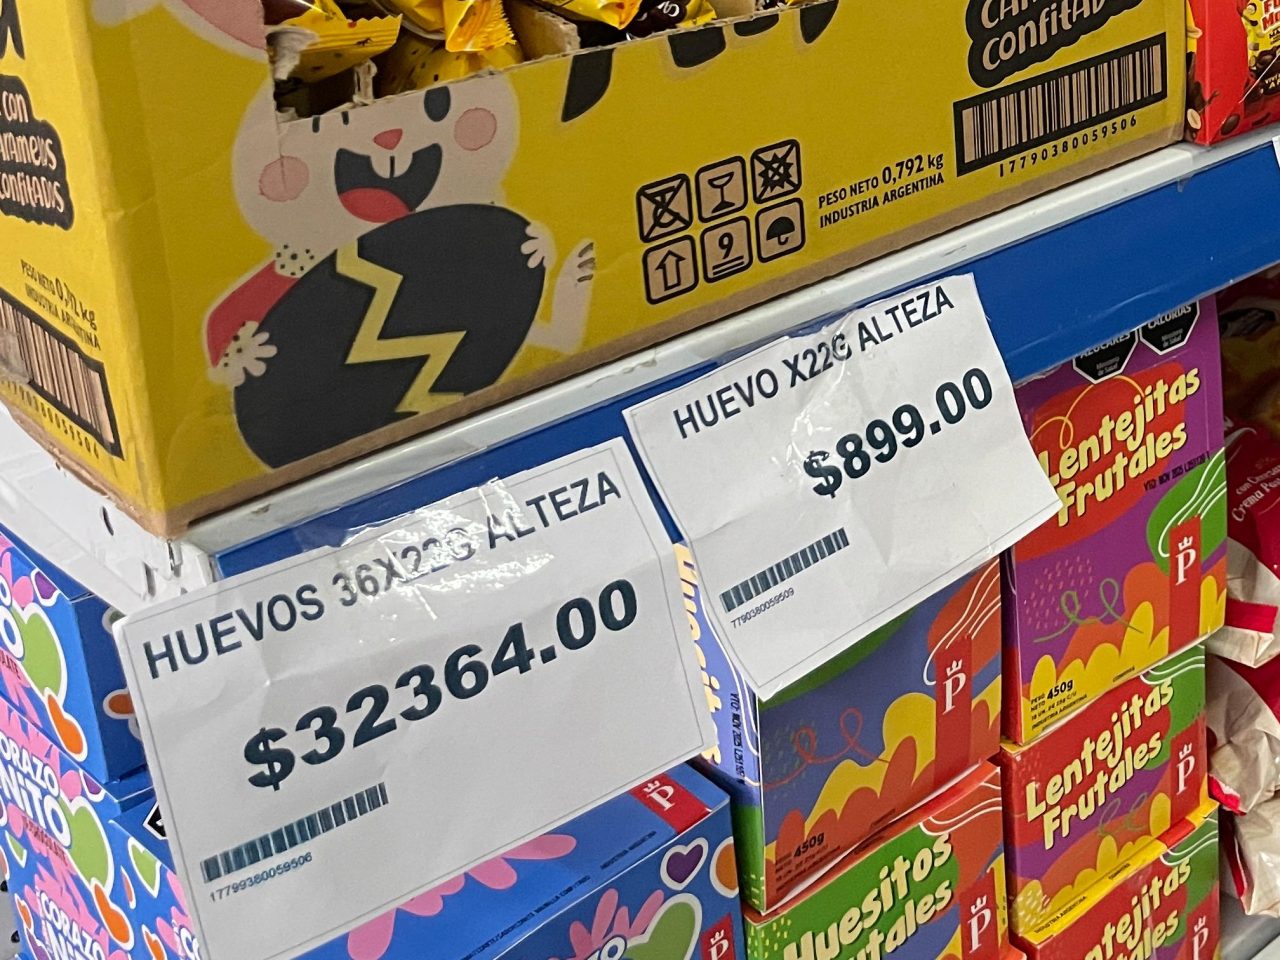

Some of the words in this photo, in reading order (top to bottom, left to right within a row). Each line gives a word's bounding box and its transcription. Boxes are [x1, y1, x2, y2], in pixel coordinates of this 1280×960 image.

[818, 188, 847, 211] PESO
[847, 176, 880, 201] NETO
[926, 153, 945, 173] kg
[818, 198, 880, 230] INDUSTRIA
[881, 172, 945, 208] ARGENTINA
[997, 115, 1138, 178] 17790380059506
[672, 367, 780, 440] HUEVO
[781, 332, 855, 388] X22G
[856, 284, 955, 352] ALTEZA
[803, 367, 994, 499] $899.00
[1038, 366, 1201, 487] Lentejitas
[1056, 421, 1188, 528] Frutales
[142, 583, 326, 680] HUEVOS
[484, 470, 622, 551] ALTEZA
[242, 578, 639, 792] $32364.00
[1046, 679, 1074, 700] 450g
[1025, 677, 1175, 823] Lentejitas
[1043, 730, 1163, 851] Frutales
